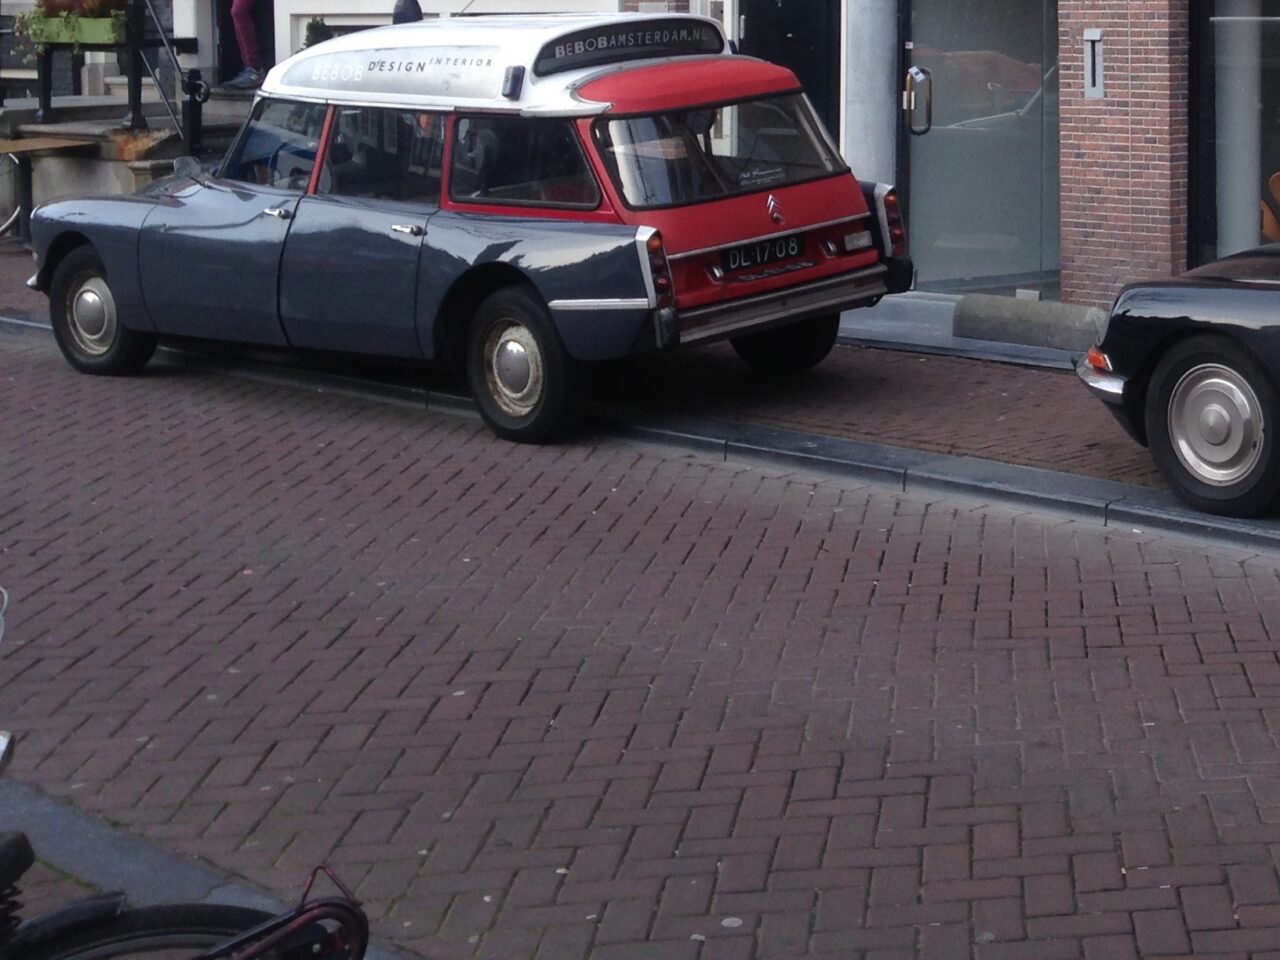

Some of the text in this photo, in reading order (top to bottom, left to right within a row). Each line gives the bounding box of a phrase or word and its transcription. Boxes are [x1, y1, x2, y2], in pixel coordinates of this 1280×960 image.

[554, 28, 708, 58] BEBOBAMSTERDAM.NL
[311, 64, 364, 81] BEBOB
[429, 57, 492, 67] INTERIOR
